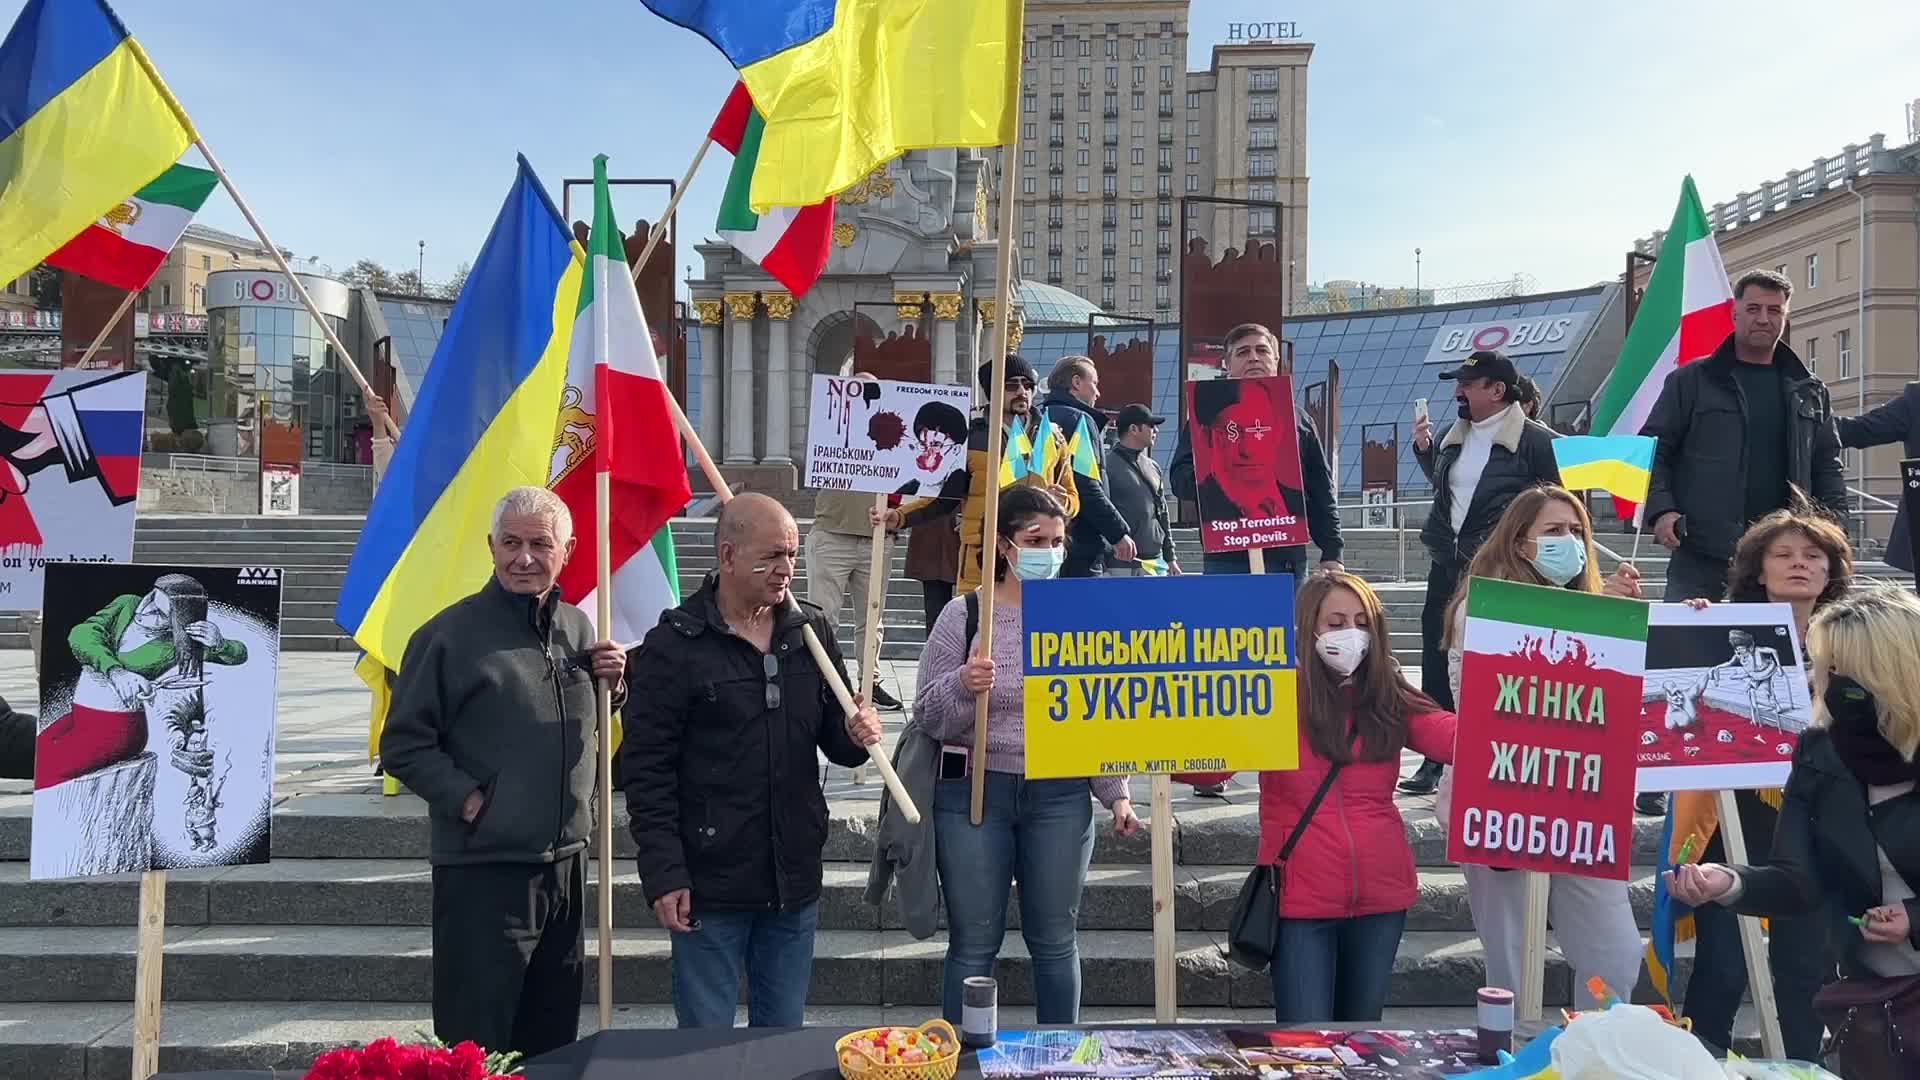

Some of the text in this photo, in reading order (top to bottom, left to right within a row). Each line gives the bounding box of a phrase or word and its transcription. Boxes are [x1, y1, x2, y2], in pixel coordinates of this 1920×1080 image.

[1228, 21, 1304, 40] HOTEL
[233, 279, 309, 303] GLOBU
[1441, 318, 1571, 352] GLOBUS
[826, 378, 863, 398] NO
[896, 385, 932, 394] FREEDOM
[933, 388, 949, 396] FOR
[811, 460, 900, 479] ДИКТАТОРСЬКОМУ
[810, 475, 853, 490] РЕЖИМУ
[1212, 515, 1296, 532] Stop Terrorists
[1224, 531, 1287, 547] Stop Devils
[3, 557, 22, 568] on
[1030, 622, 1287, 667] ІРАНСЬКИЙ НАРОД
[1048, 679, 1068, 721] З
[1488, 741, 1602, 792] ЖИТТЯ
[1463, 807, 1616, 864] СВОБОДА
